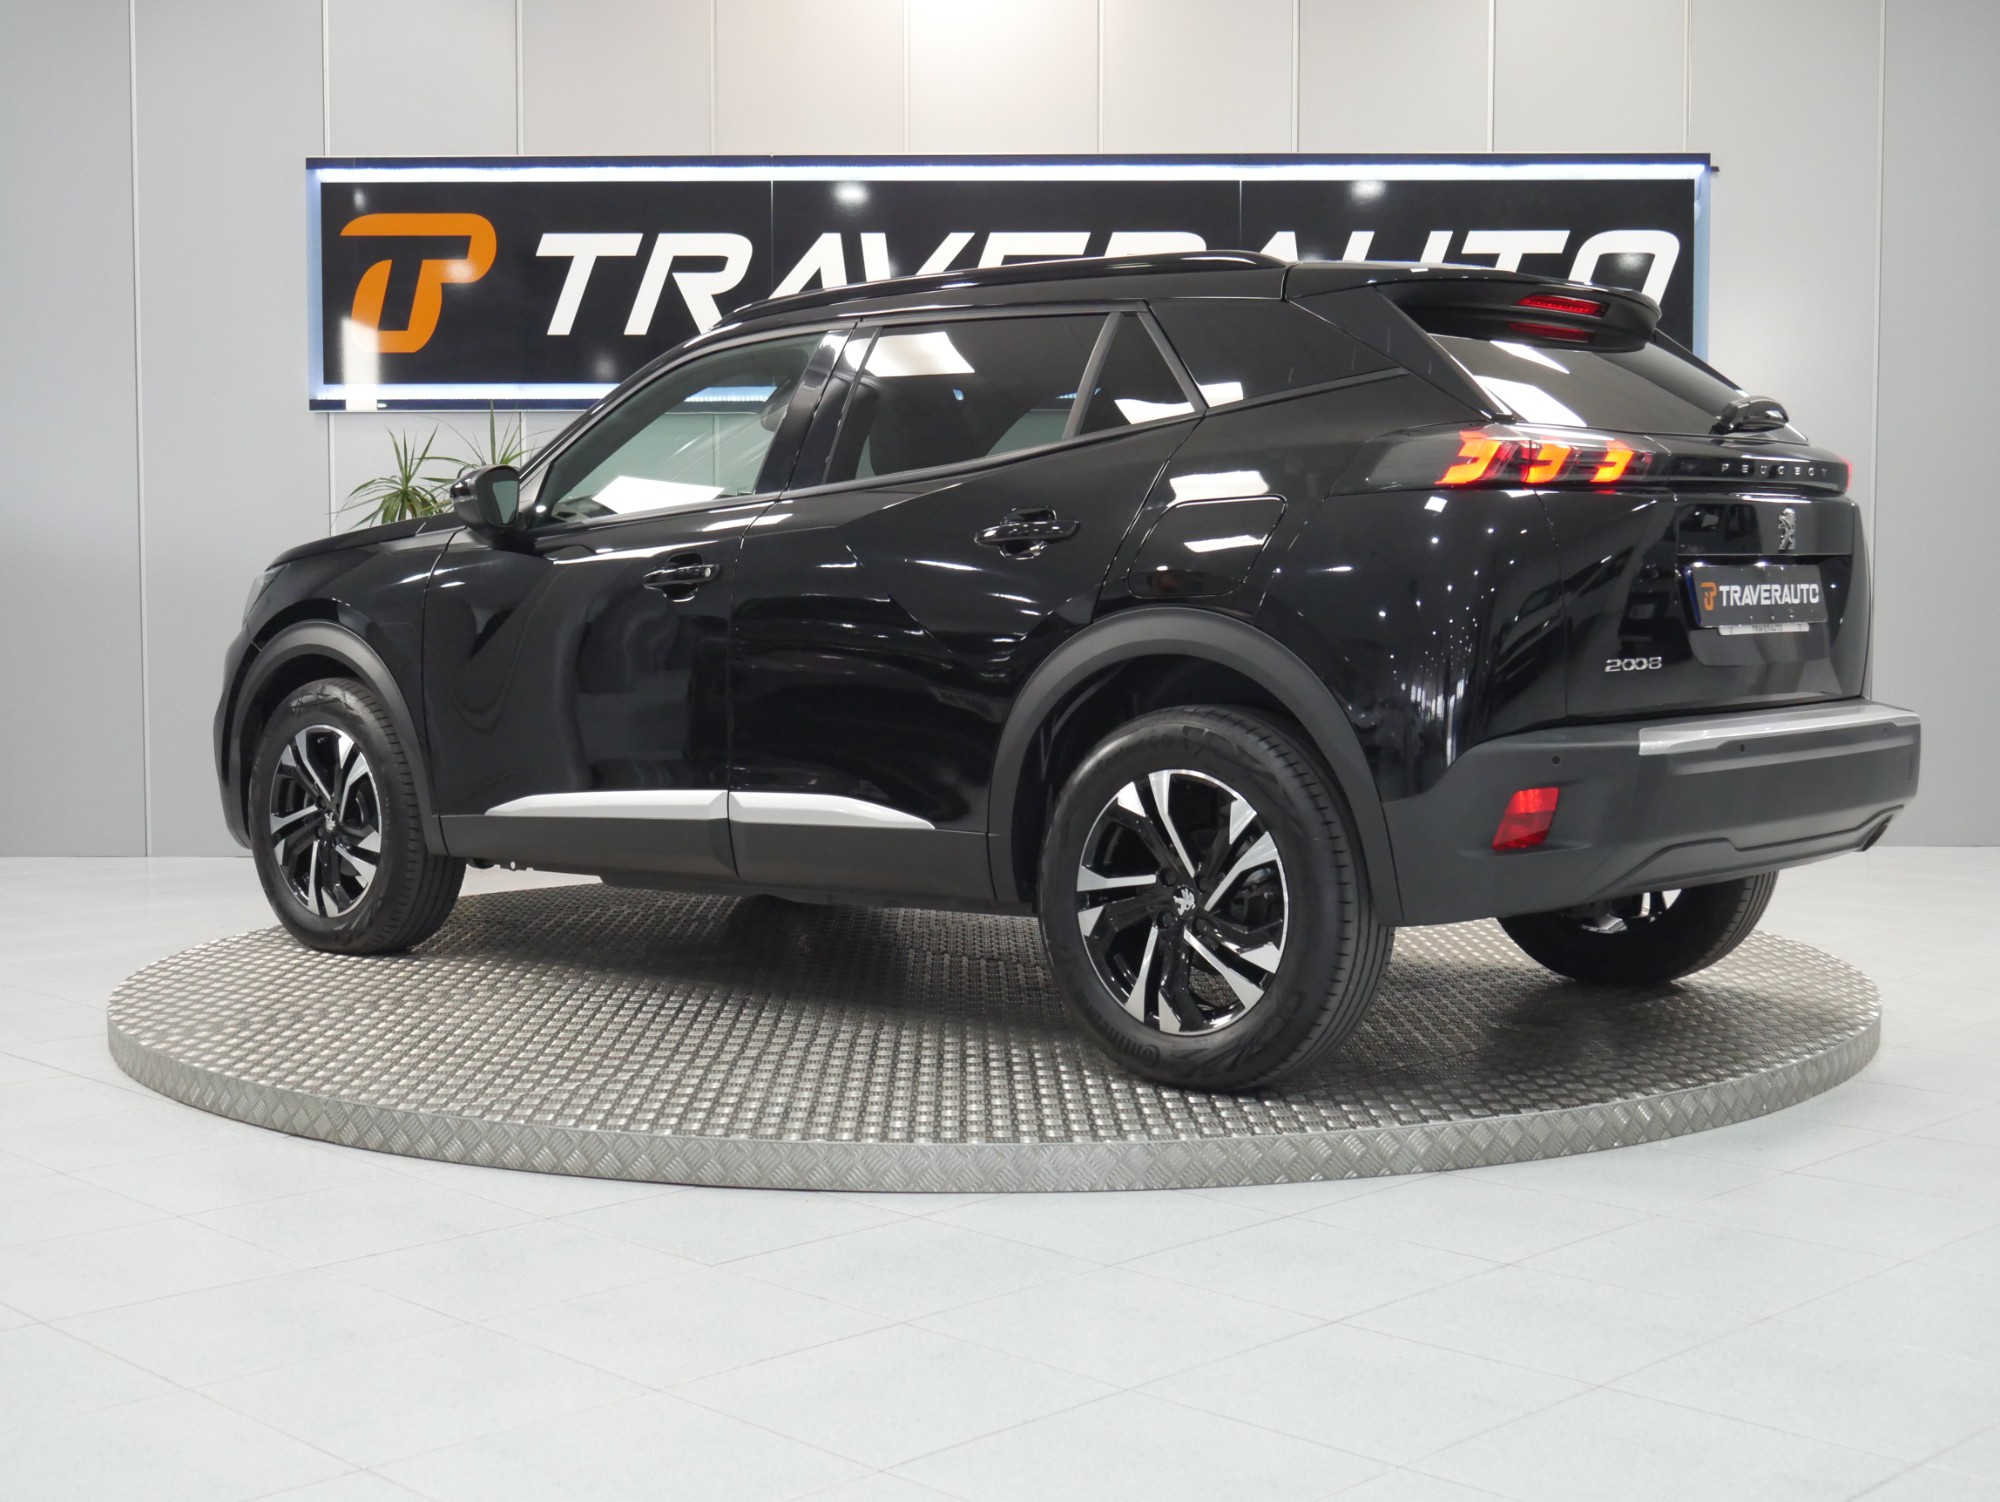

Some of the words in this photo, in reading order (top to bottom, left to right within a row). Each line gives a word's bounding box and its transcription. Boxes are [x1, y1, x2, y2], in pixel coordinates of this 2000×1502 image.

[1721, 463, 1827, 477] PEUGEOT
[1719, 583, 1820, 607] TRAVERAUTO
[1605, 656, 1662, 672] 2008
